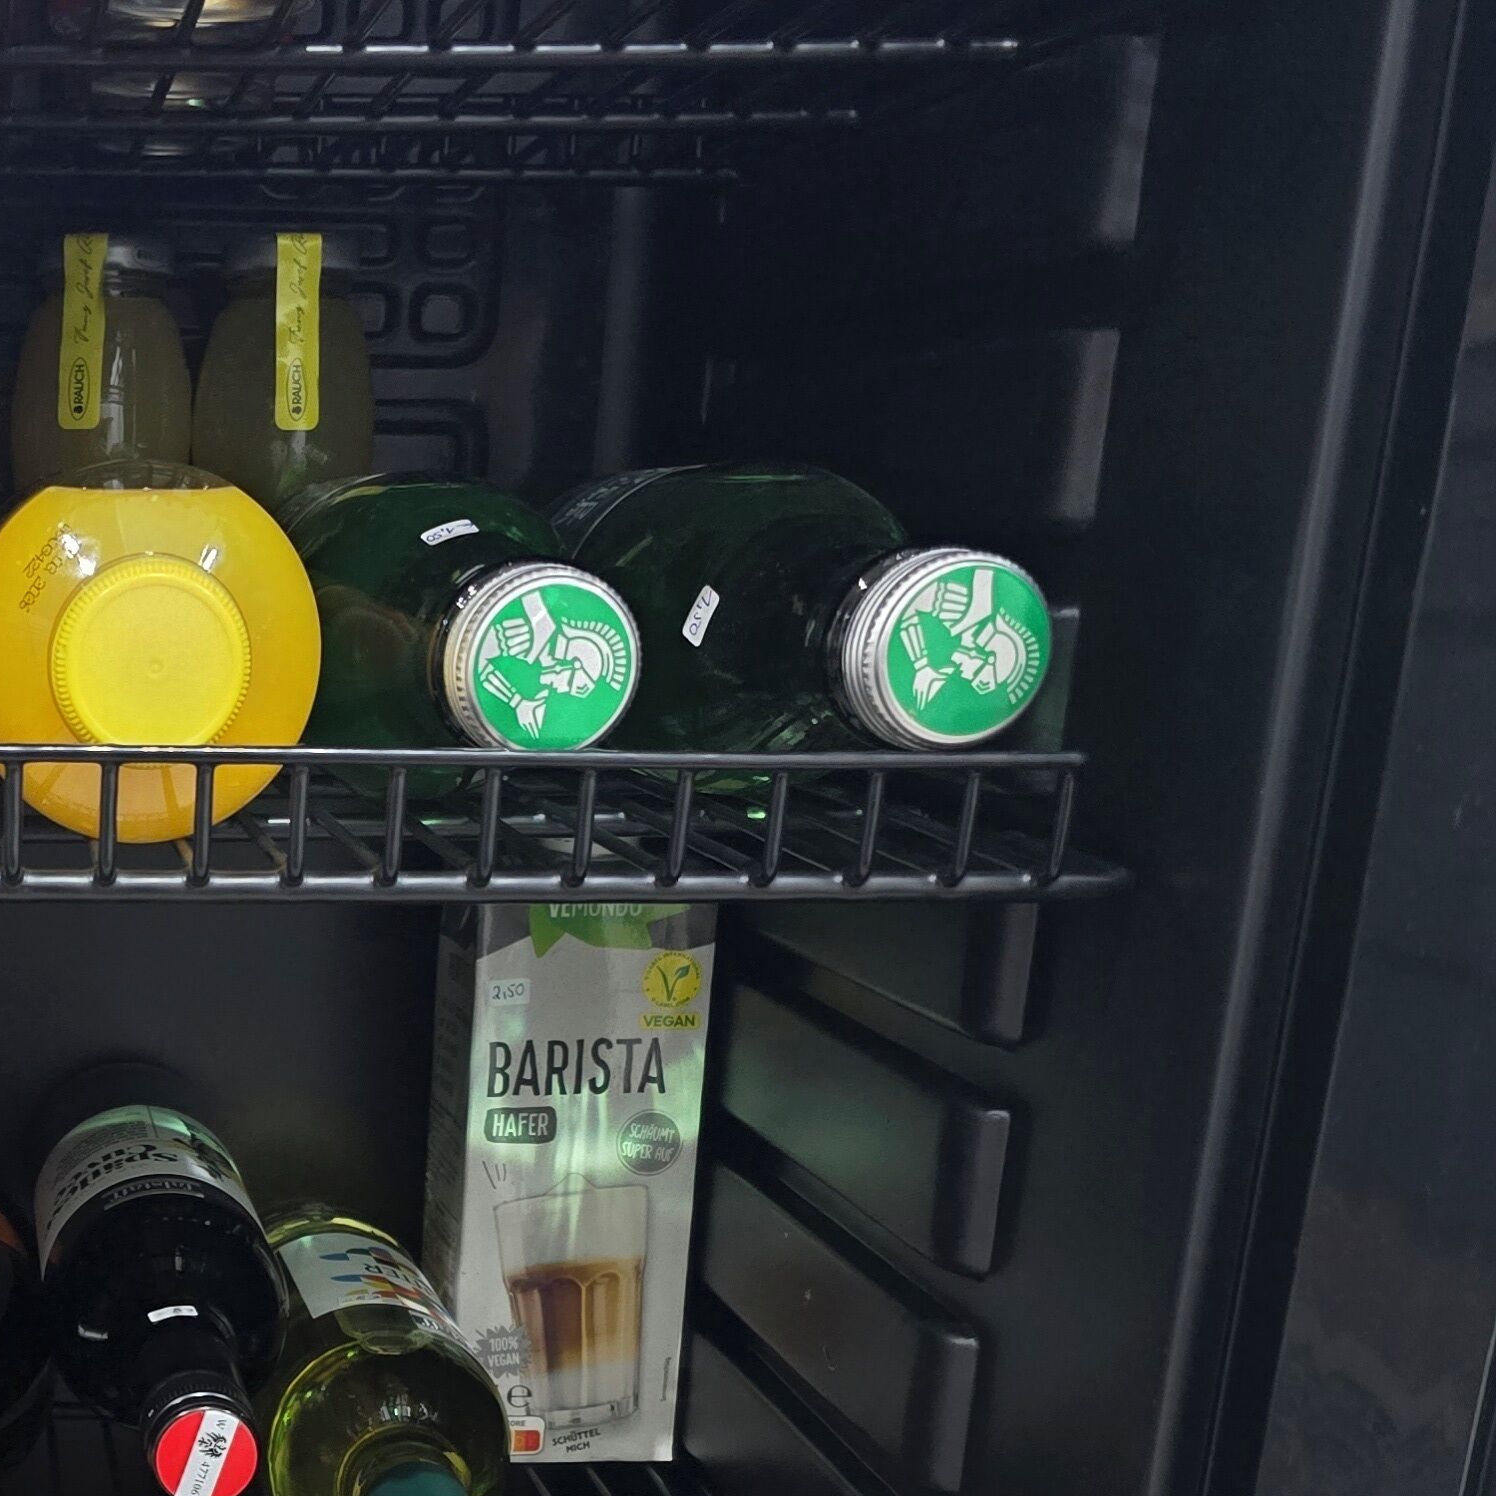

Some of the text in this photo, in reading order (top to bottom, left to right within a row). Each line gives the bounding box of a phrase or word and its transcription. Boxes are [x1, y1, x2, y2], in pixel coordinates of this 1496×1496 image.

[73, 363, 85, 405] RAUCH
[292, 363, 303, 405] RAUCH
[643, 1014, 696, 1028] VEGAN
[486, 1037, 666, 1098] BARISTA
[491, 1111, 549, 1138] HAFER
[488, 1337, 519, 1352] 100%
[486, 1352, 521, 1368] VEGAN
[552, 1428, 601, 1447] SCHÜTTEL
[566, 1440, 591, 1454] MICH
